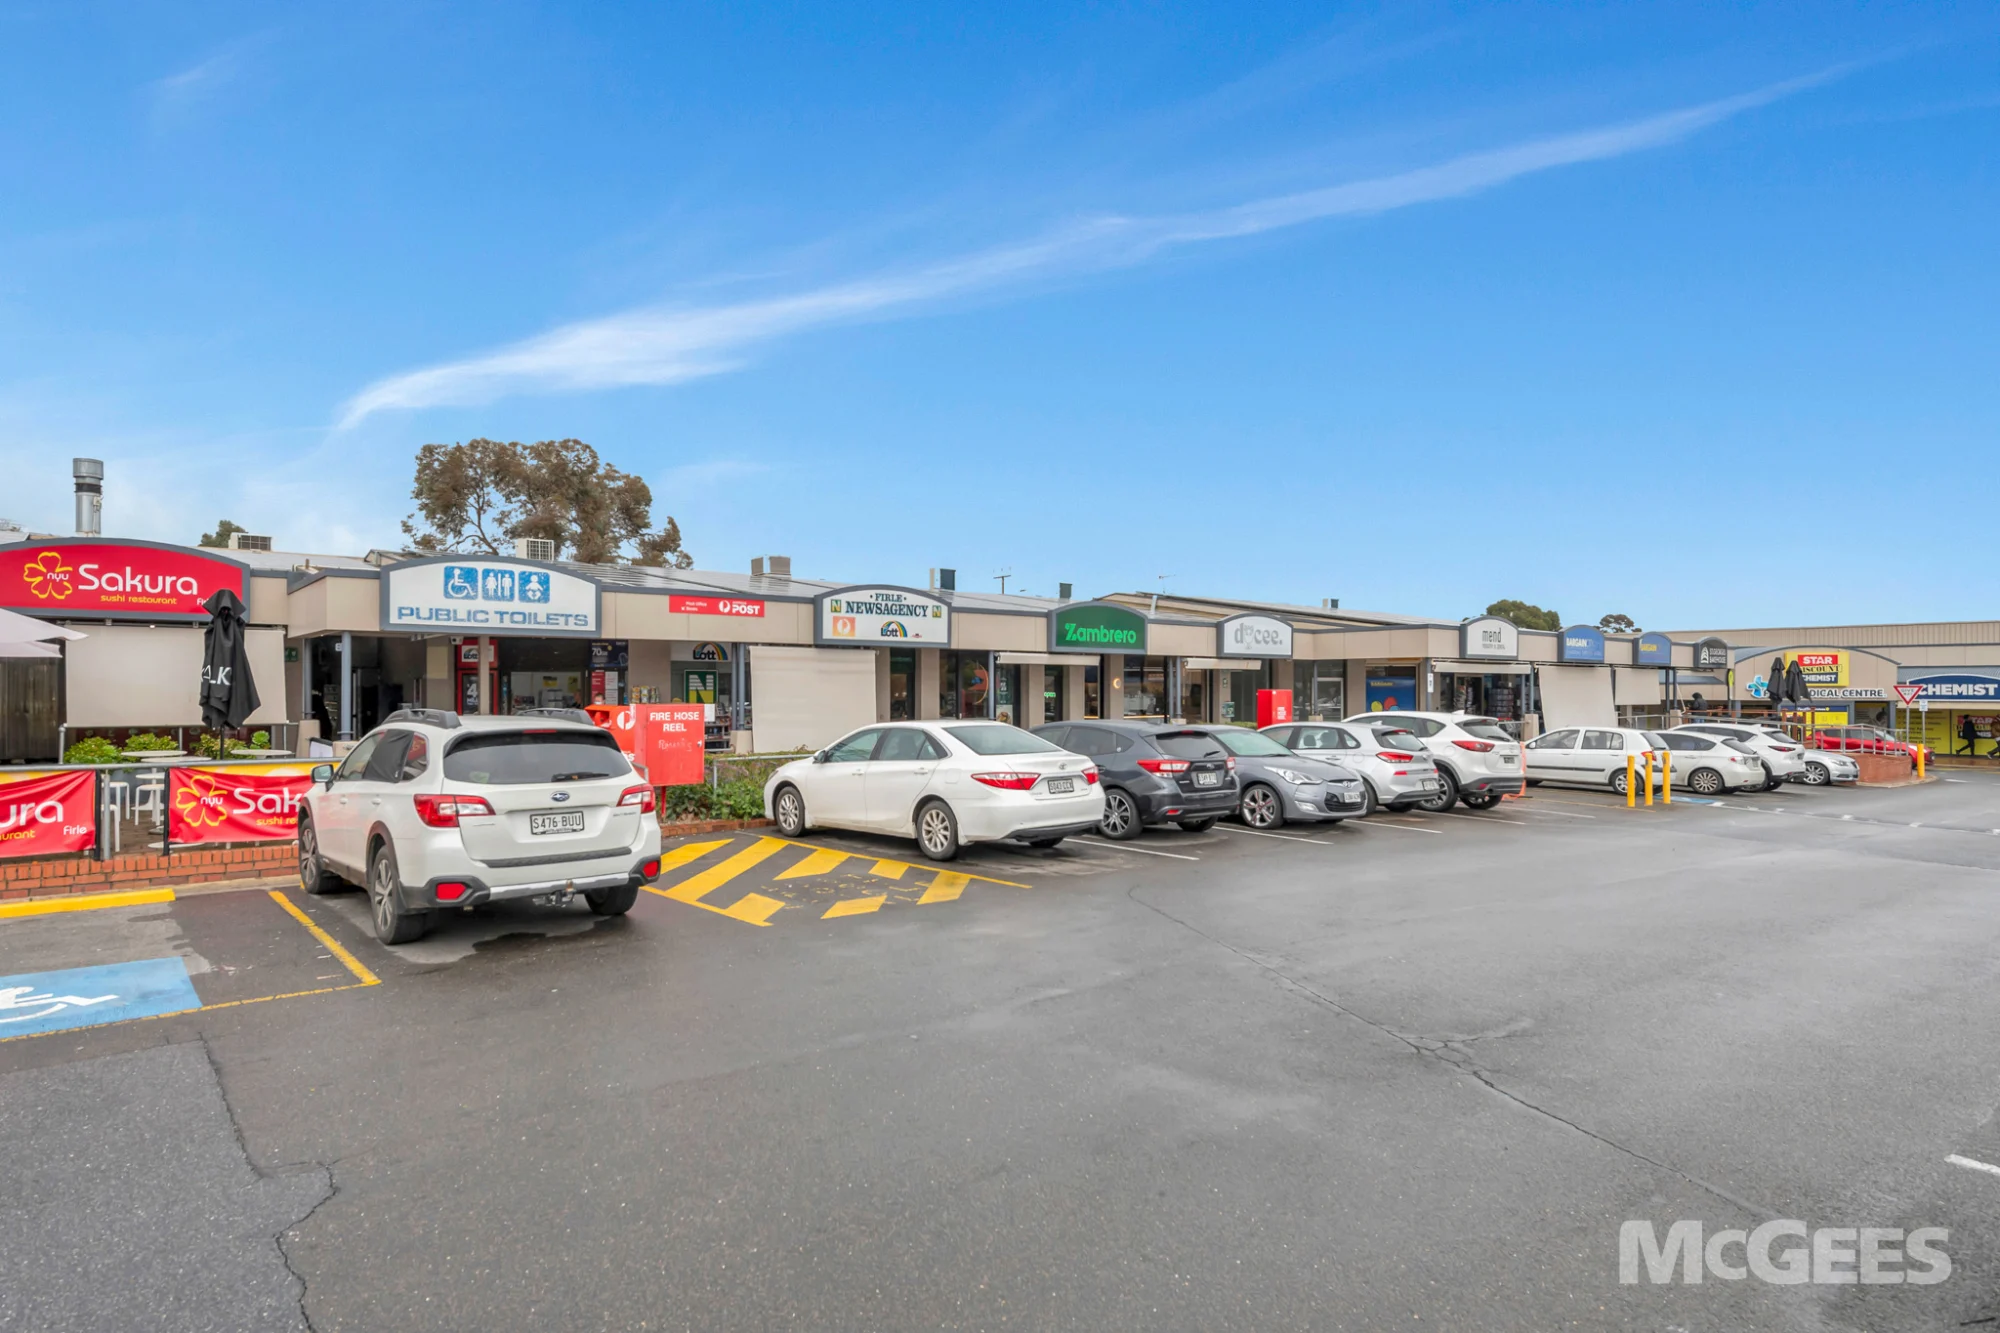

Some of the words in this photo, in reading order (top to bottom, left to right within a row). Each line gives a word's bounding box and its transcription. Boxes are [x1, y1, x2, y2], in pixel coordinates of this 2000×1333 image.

[47, 572, 69, 582] nyu
[78, 564, 198, 595] Sakura
[100, 594, 126, 603] sushi
[128, 596, 177, 605] restaurant
[875, 593, 902, 602] FIRLE
[732, 604, 760, 615] POST
[845, 601, 928, 617] NEWSAGENCY
[397, 606, 489, 623] PUBLIC
[494, 610, 588, 627] TOILETS
[881, 628, 898, 637] Lott
[1065, 623, 1136, 643] Zambrero
[1482, 627, 1501, 643] mend
[693, 650, 716, 660] Lott
[1803, 656, 1833, 664] STAR
[1801, 665, 1839, 673] ISCOUNT
[1810, 689, 1839, 697] DICAL
[1842, 689, 1884, 697] CENTRE
[1918, 684, 1998, 696] CHEMIST
[650, 712, 671, 721] FIRE
[674, 712, 700, 720] HOSE
[663, 723, 687, 732] REEL
[200, 797, 223, 807] nyu
[233, 787, 302, 814] Sak
[0, 800, 63, 828] ura
[256, 816, 282, 825] sushi
[63, 825, 87, 835] Firle
